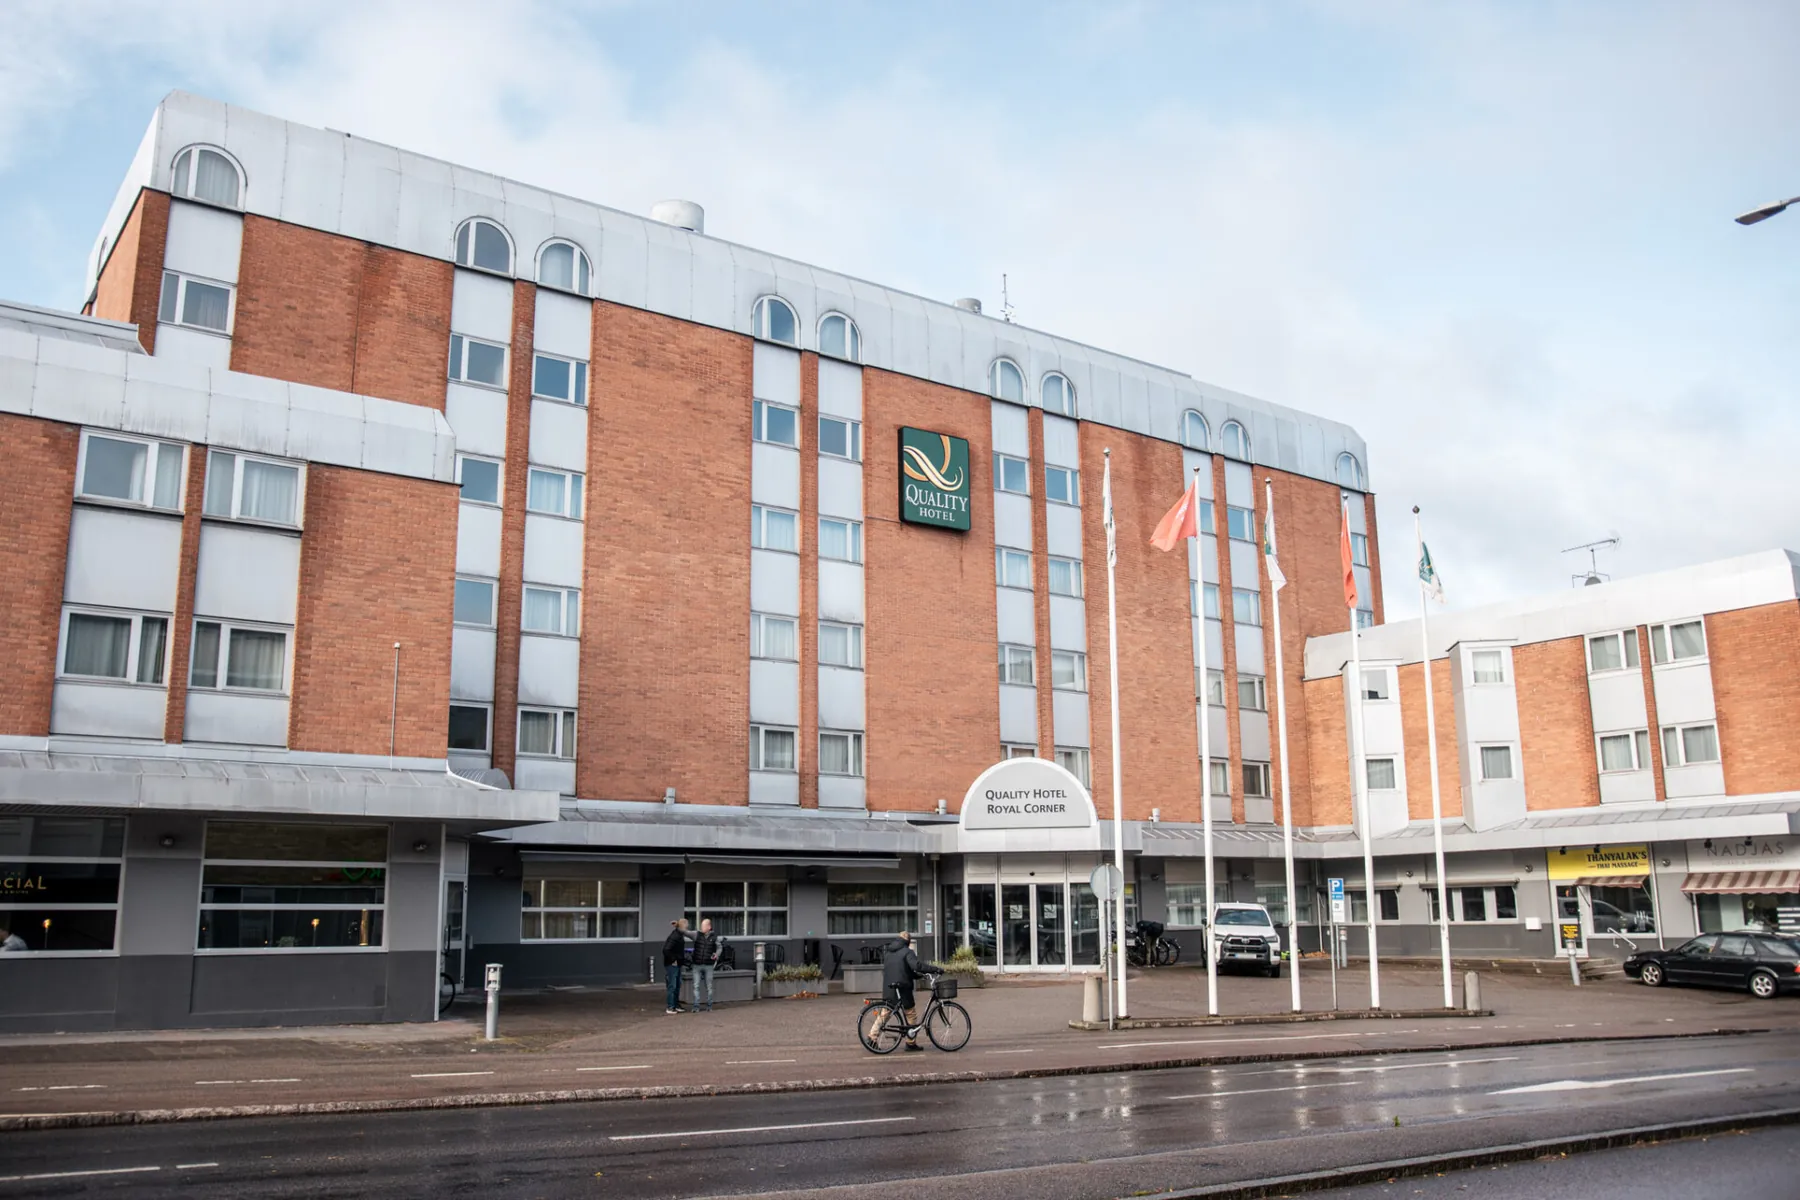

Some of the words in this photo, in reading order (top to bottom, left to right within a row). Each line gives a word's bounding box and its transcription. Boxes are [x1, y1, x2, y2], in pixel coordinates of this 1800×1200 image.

[906, 484, 968, 512] QUALITY
[920, 508, 955, 521] HOTEL
[985, 789, 1030, 801] QUALITY
[1033, 788, 1067, 799] HOTEL
[987, 804, 1021, 814] ROYAL
[1024, 803, 1066, 814] CORNER
[1705, 841, 1785, 856] NADJAS
[1586, 850, 1647, 862] THANYALAK'S
[0, 876, 47, 889] CIAL
[1331, 880, 1340, 892] P
